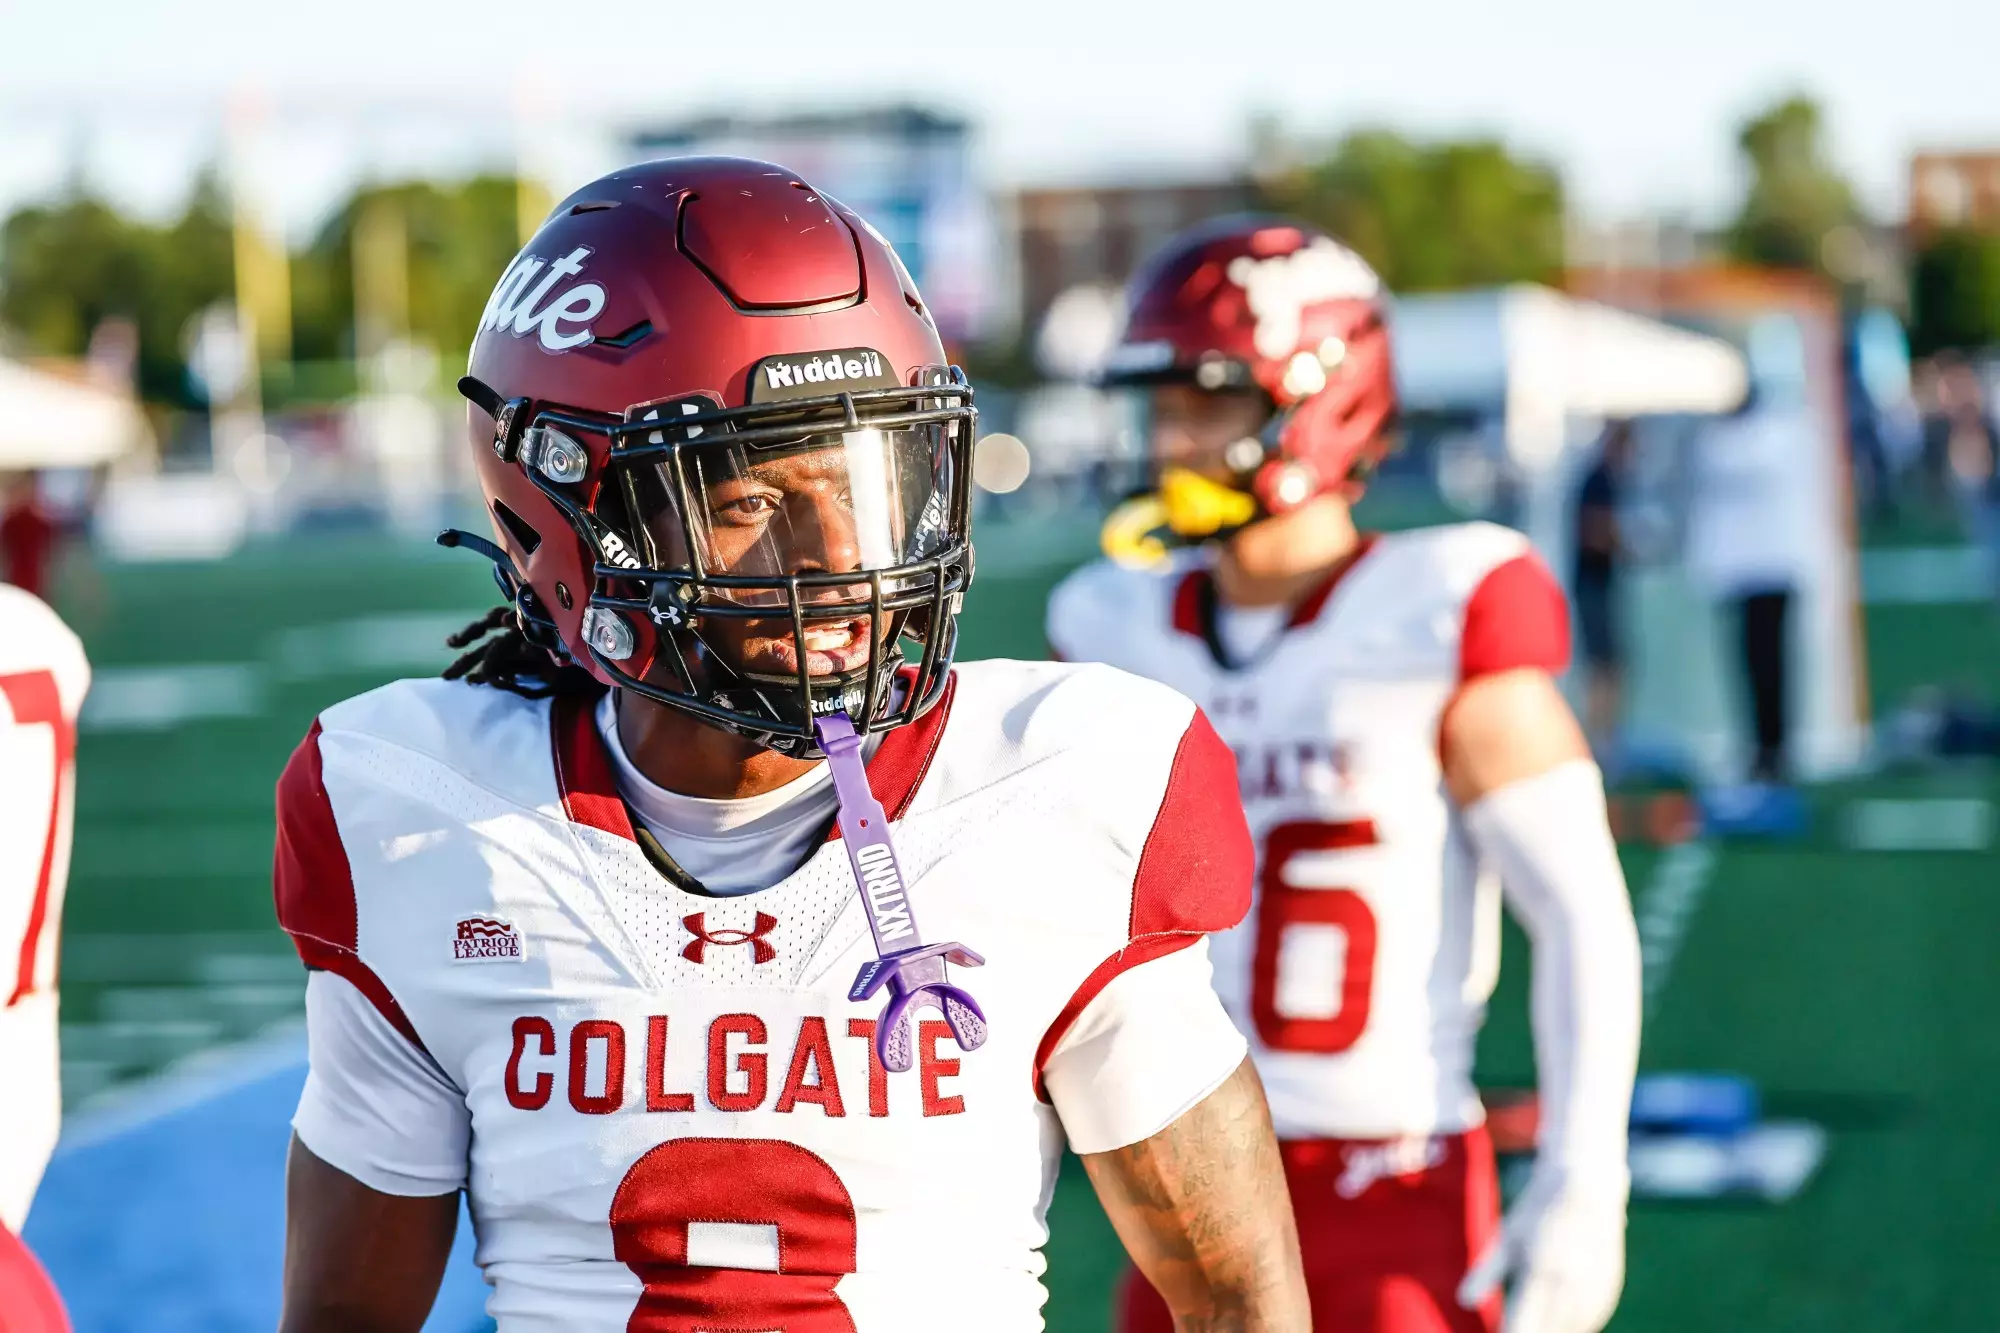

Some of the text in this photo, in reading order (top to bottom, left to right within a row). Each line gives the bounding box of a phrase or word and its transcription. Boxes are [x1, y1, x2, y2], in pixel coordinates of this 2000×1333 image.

[484, 247, 607, 350] ate
[764, 352, 882, 388] Riddell
[453, 937, 518, 949] PATRIOT
[857, 843, 914, 943] NXTRND
[1250, 820, 1380, 1053] 6
[454, 946, 520, 959] LEAGUE
[504, 1013, 966, 1118] COLGATE
